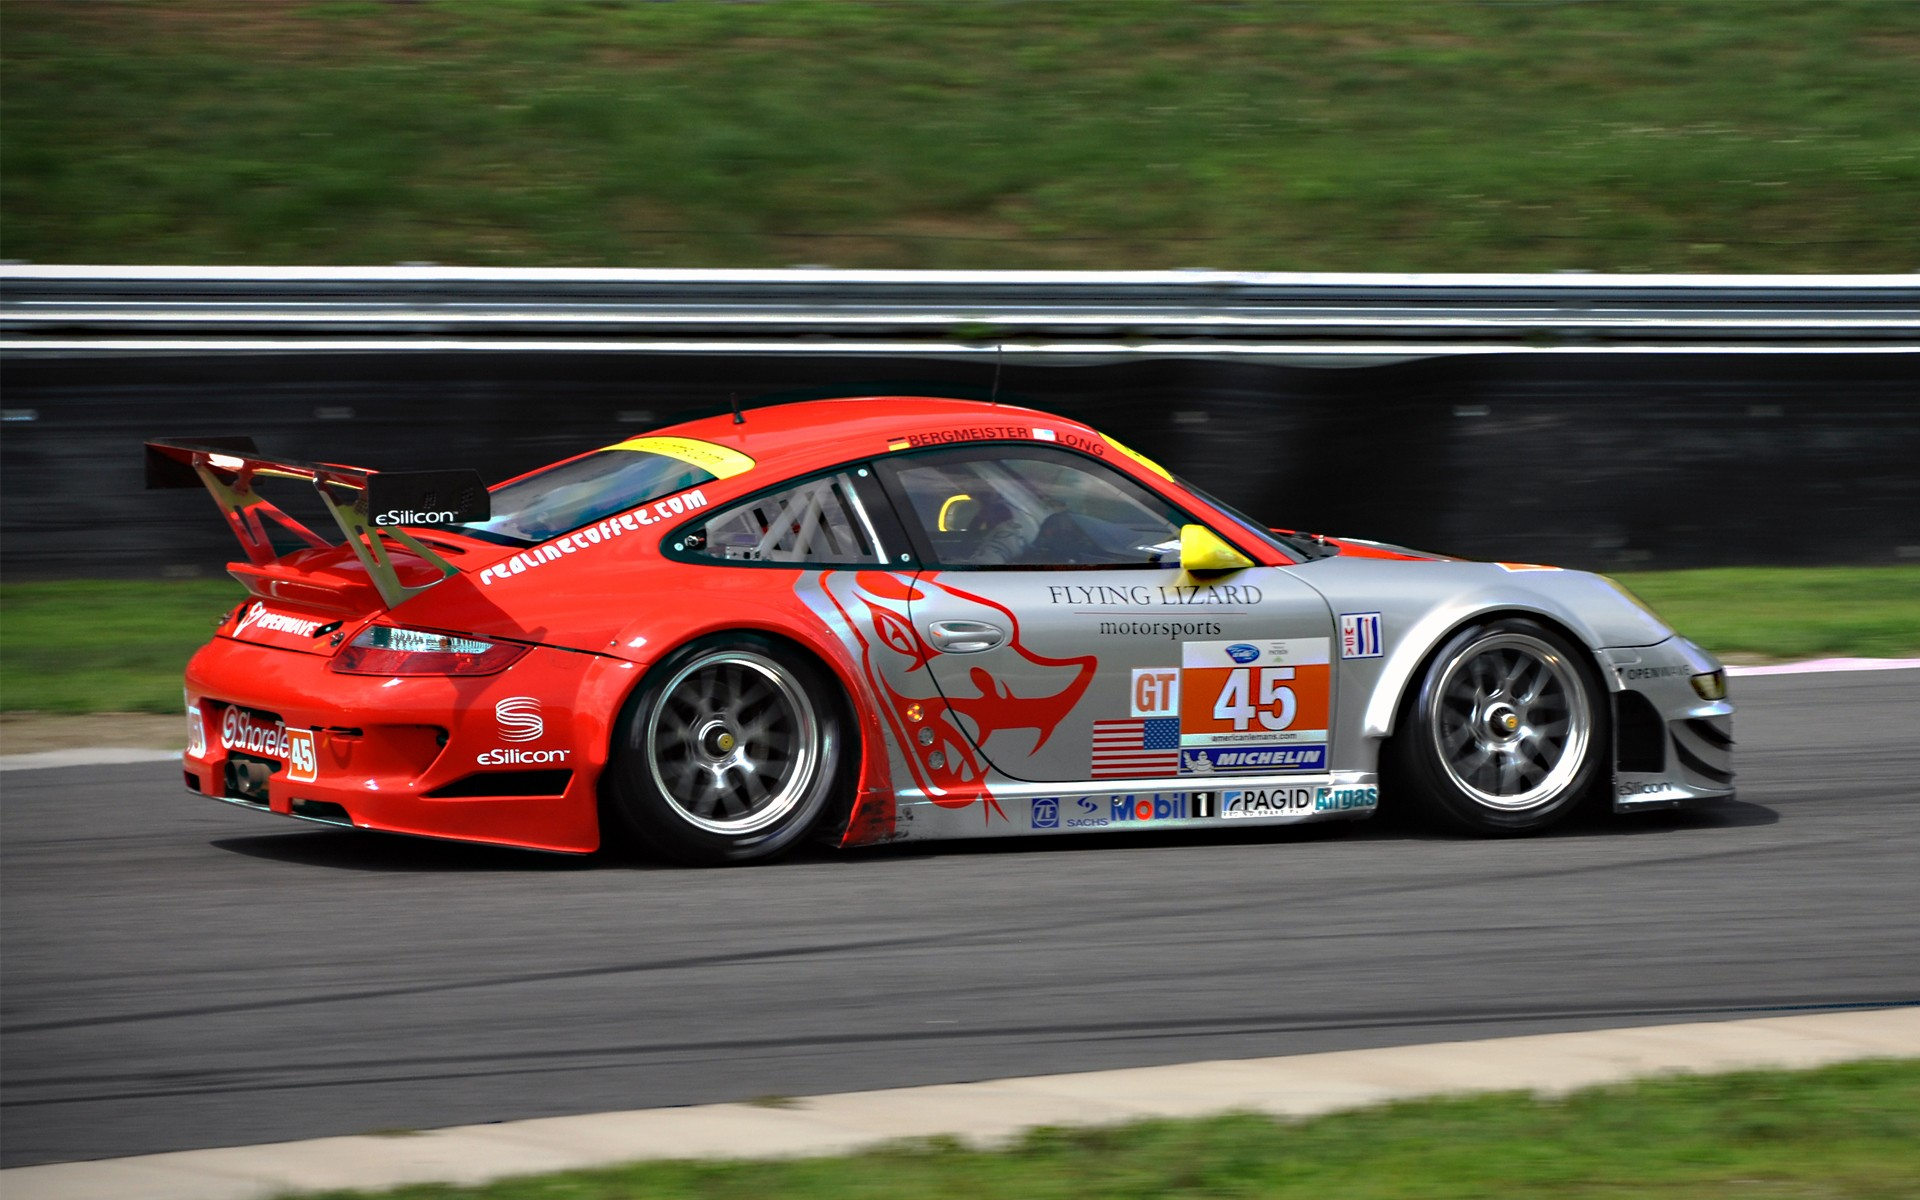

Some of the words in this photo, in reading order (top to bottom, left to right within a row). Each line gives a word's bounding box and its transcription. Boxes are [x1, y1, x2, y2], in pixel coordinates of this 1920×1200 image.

[909, 426, 1029, 447] BERGMEISTER
[1054, 431, 1105, 456] LONG
[375, 509, 455, 526] eSilicon
[1047, 585, 1151, 606] FLYING
[1157, 585, 1263, 605] LIZARD
[256, 612, 316, 637] OPENWAVE
[1099, 621, 1221, 640] motorsports
[1344, 617, 1355, 656] IMSA
[1136, 673, 1176, 712] GT
[1212, 666, 1298, 732] 45
[1211, 733, 1297, 743] americanlemans.com
[291, 737, 314, 773] 45
[476, 748, 567, 766] eSilicon
[1216, 750, 1322, 767] MICHELIN
[1110, 793, 1186, 822] Mobil
[1197, 792, 1209, 817] 1
[1243, 789, 1310, 812] PAGID
[1314, 786, 1378, 812] Airgas
[1066, 817, 1109, 828] SACHS
